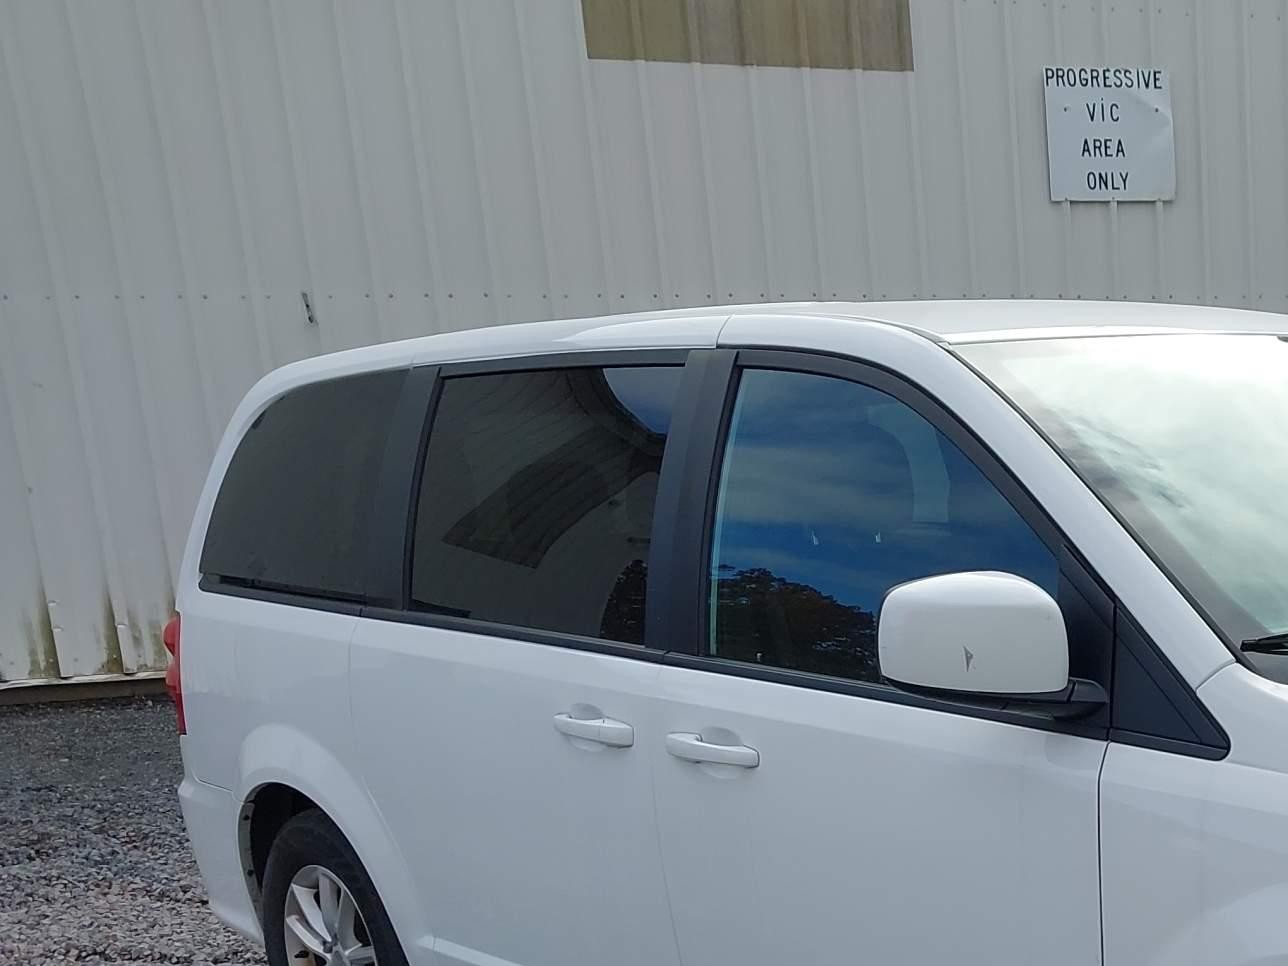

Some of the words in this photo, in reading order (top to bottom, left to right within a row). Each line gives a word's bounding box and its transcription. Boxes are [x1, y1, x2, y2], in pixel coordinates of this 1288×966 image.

[1045, 67, 1163, 90] PROGRESSIVE
[1081, 138, 1126, 158] AREA
[1086, 171, 1129, 191] ONLY
